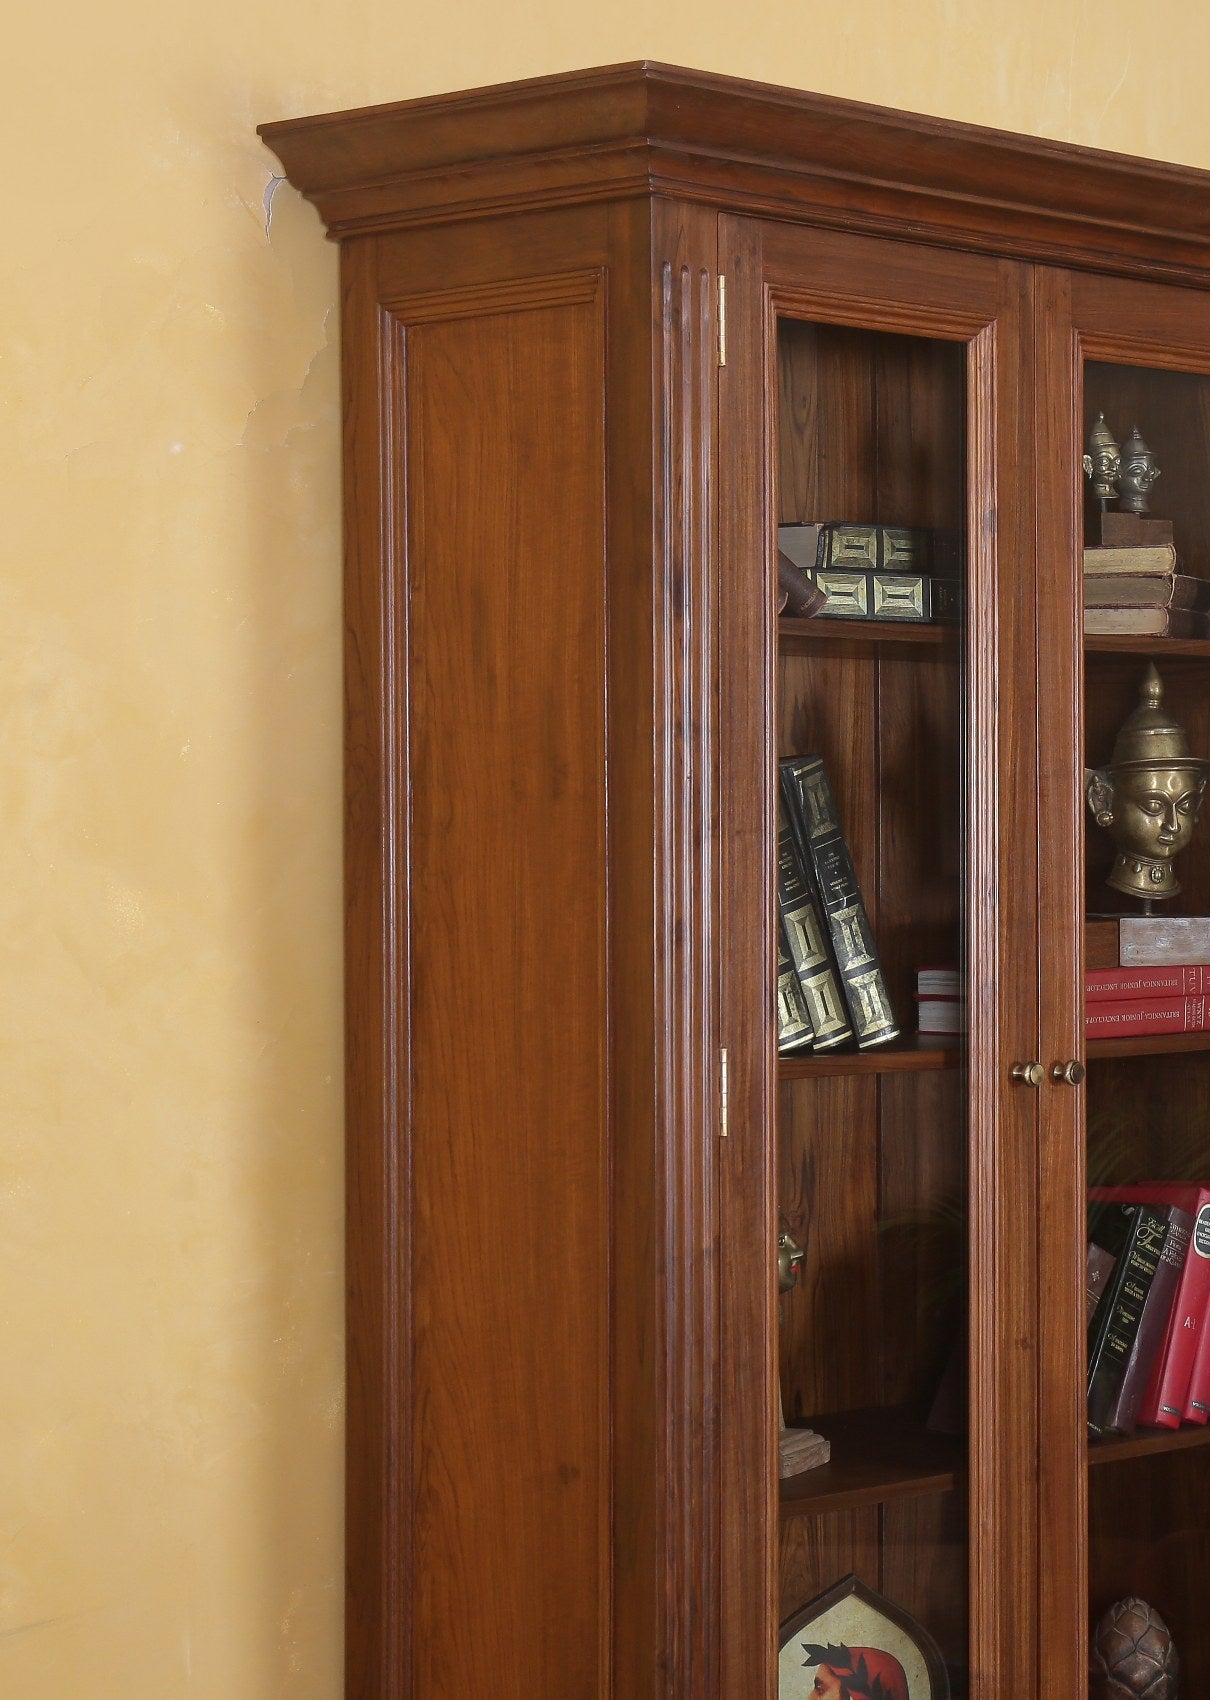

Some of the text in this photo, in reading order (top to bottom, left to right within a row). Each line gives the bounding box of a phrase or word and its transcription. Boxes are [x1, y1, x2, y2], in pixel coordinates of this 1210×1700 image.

[1086, 982, 1119, 992] ENCYCLOP
[1143, 979, 1178, 989] BRITANNICA
[1121, 1010, 1144, 1022] JUNIOR
[1144, 1010, 1180, 1020] BRITANNICA
